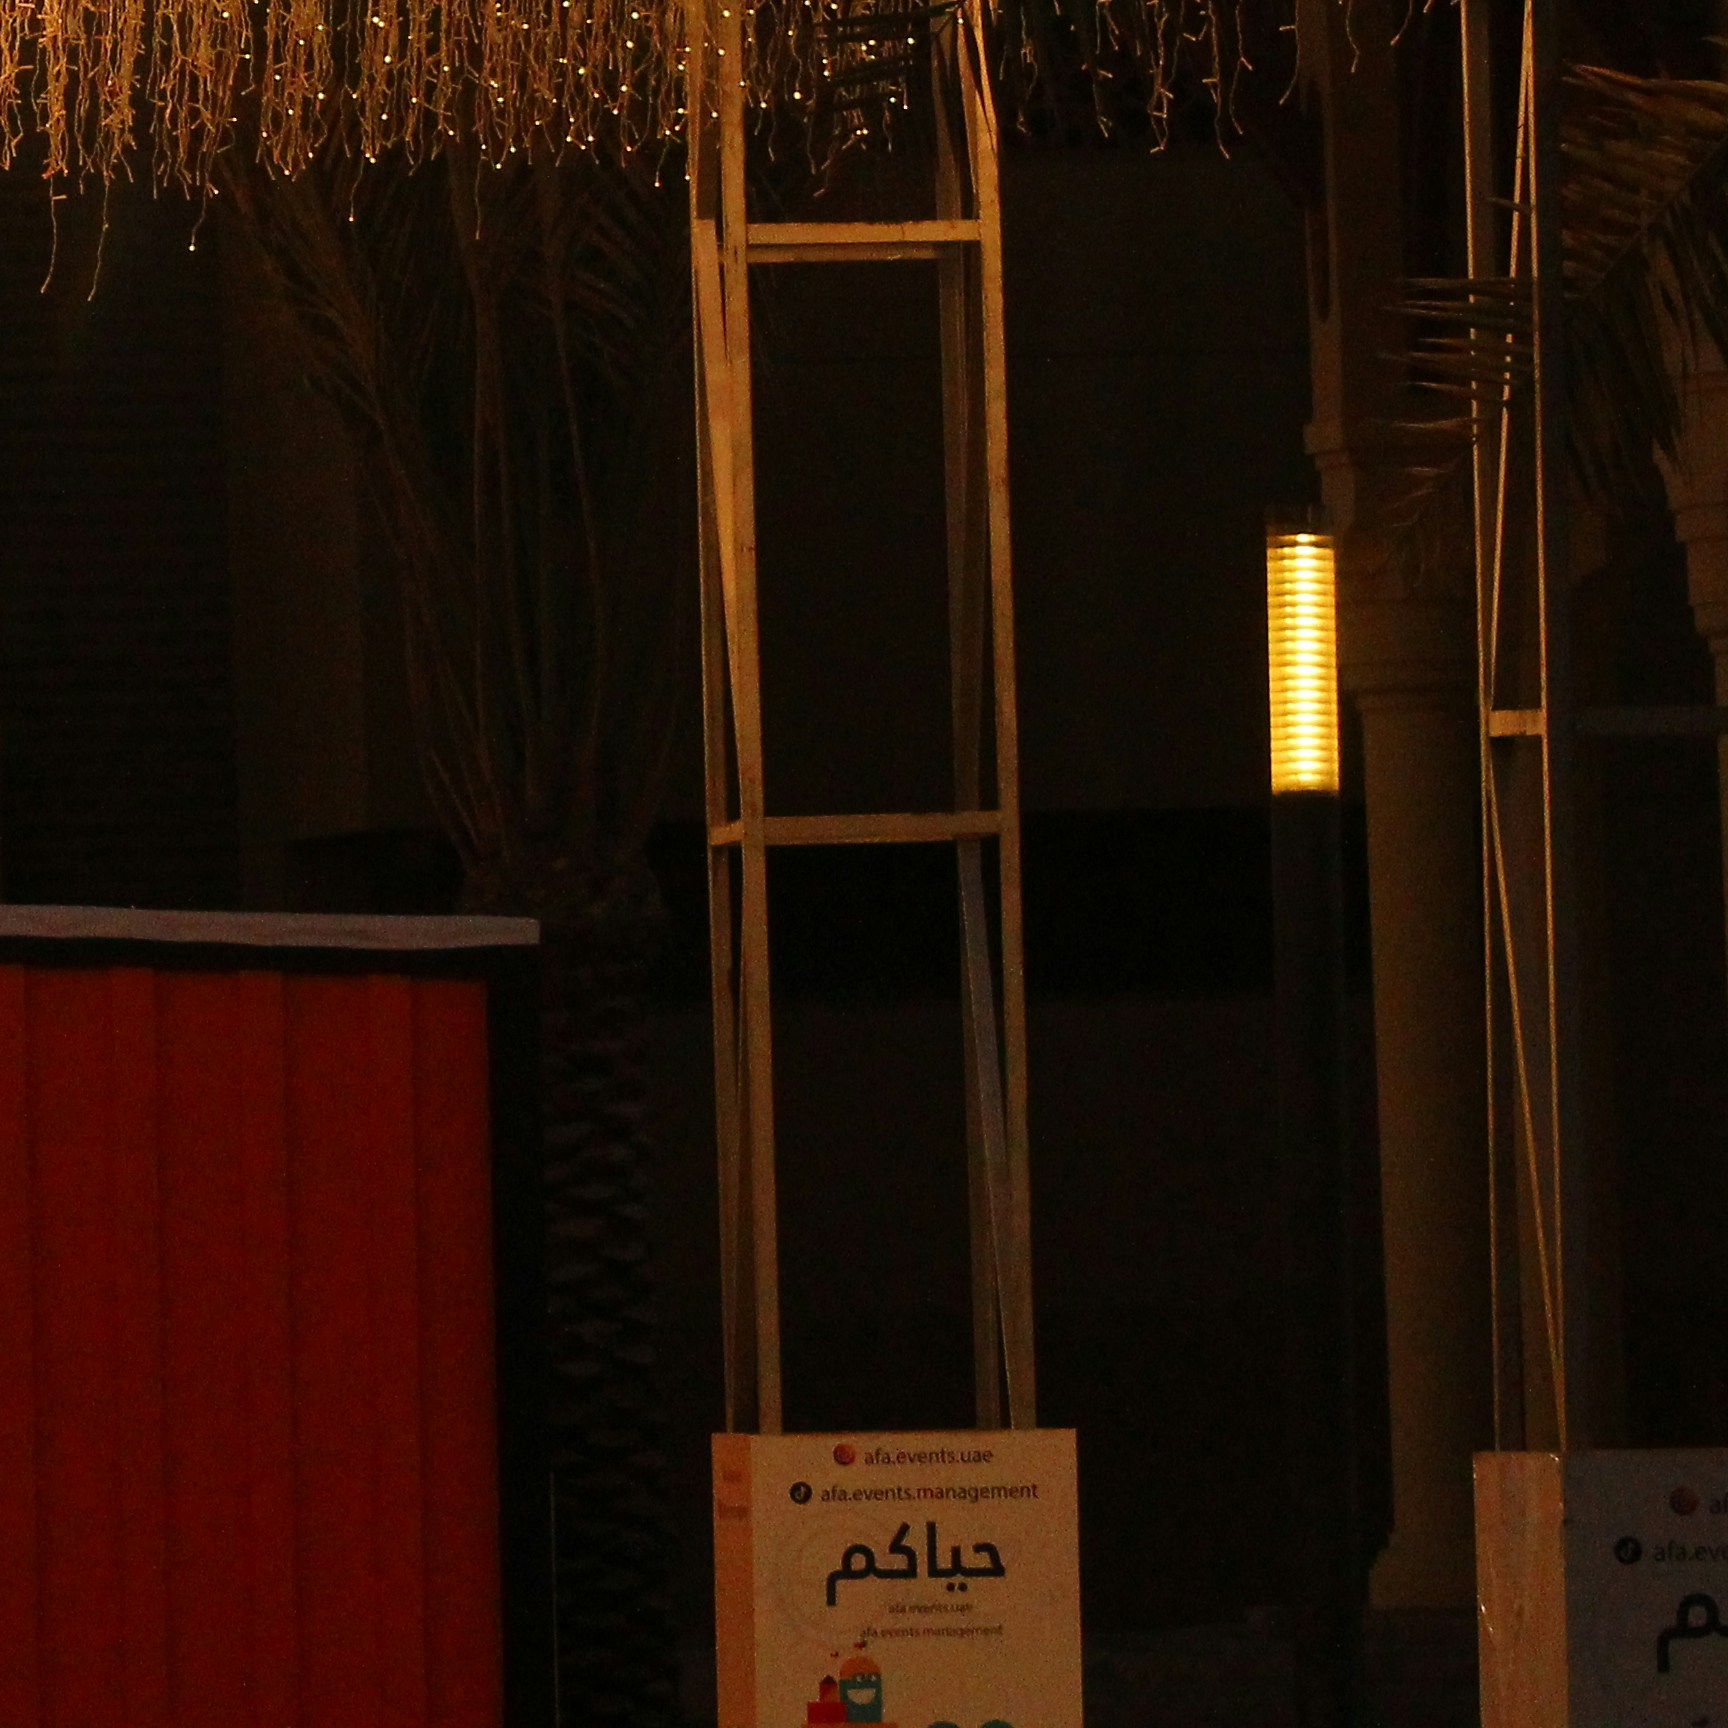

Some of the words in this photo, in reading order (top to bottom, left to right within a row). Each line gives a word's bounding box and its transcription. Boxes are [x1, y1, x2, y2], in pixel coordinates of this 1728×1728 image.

[864, 1447, 994, 1465] afa.events.uae
[820, 1483, 1039, 1504] afa.events.management
[826, 1521, 1006, 1607] حياكم
